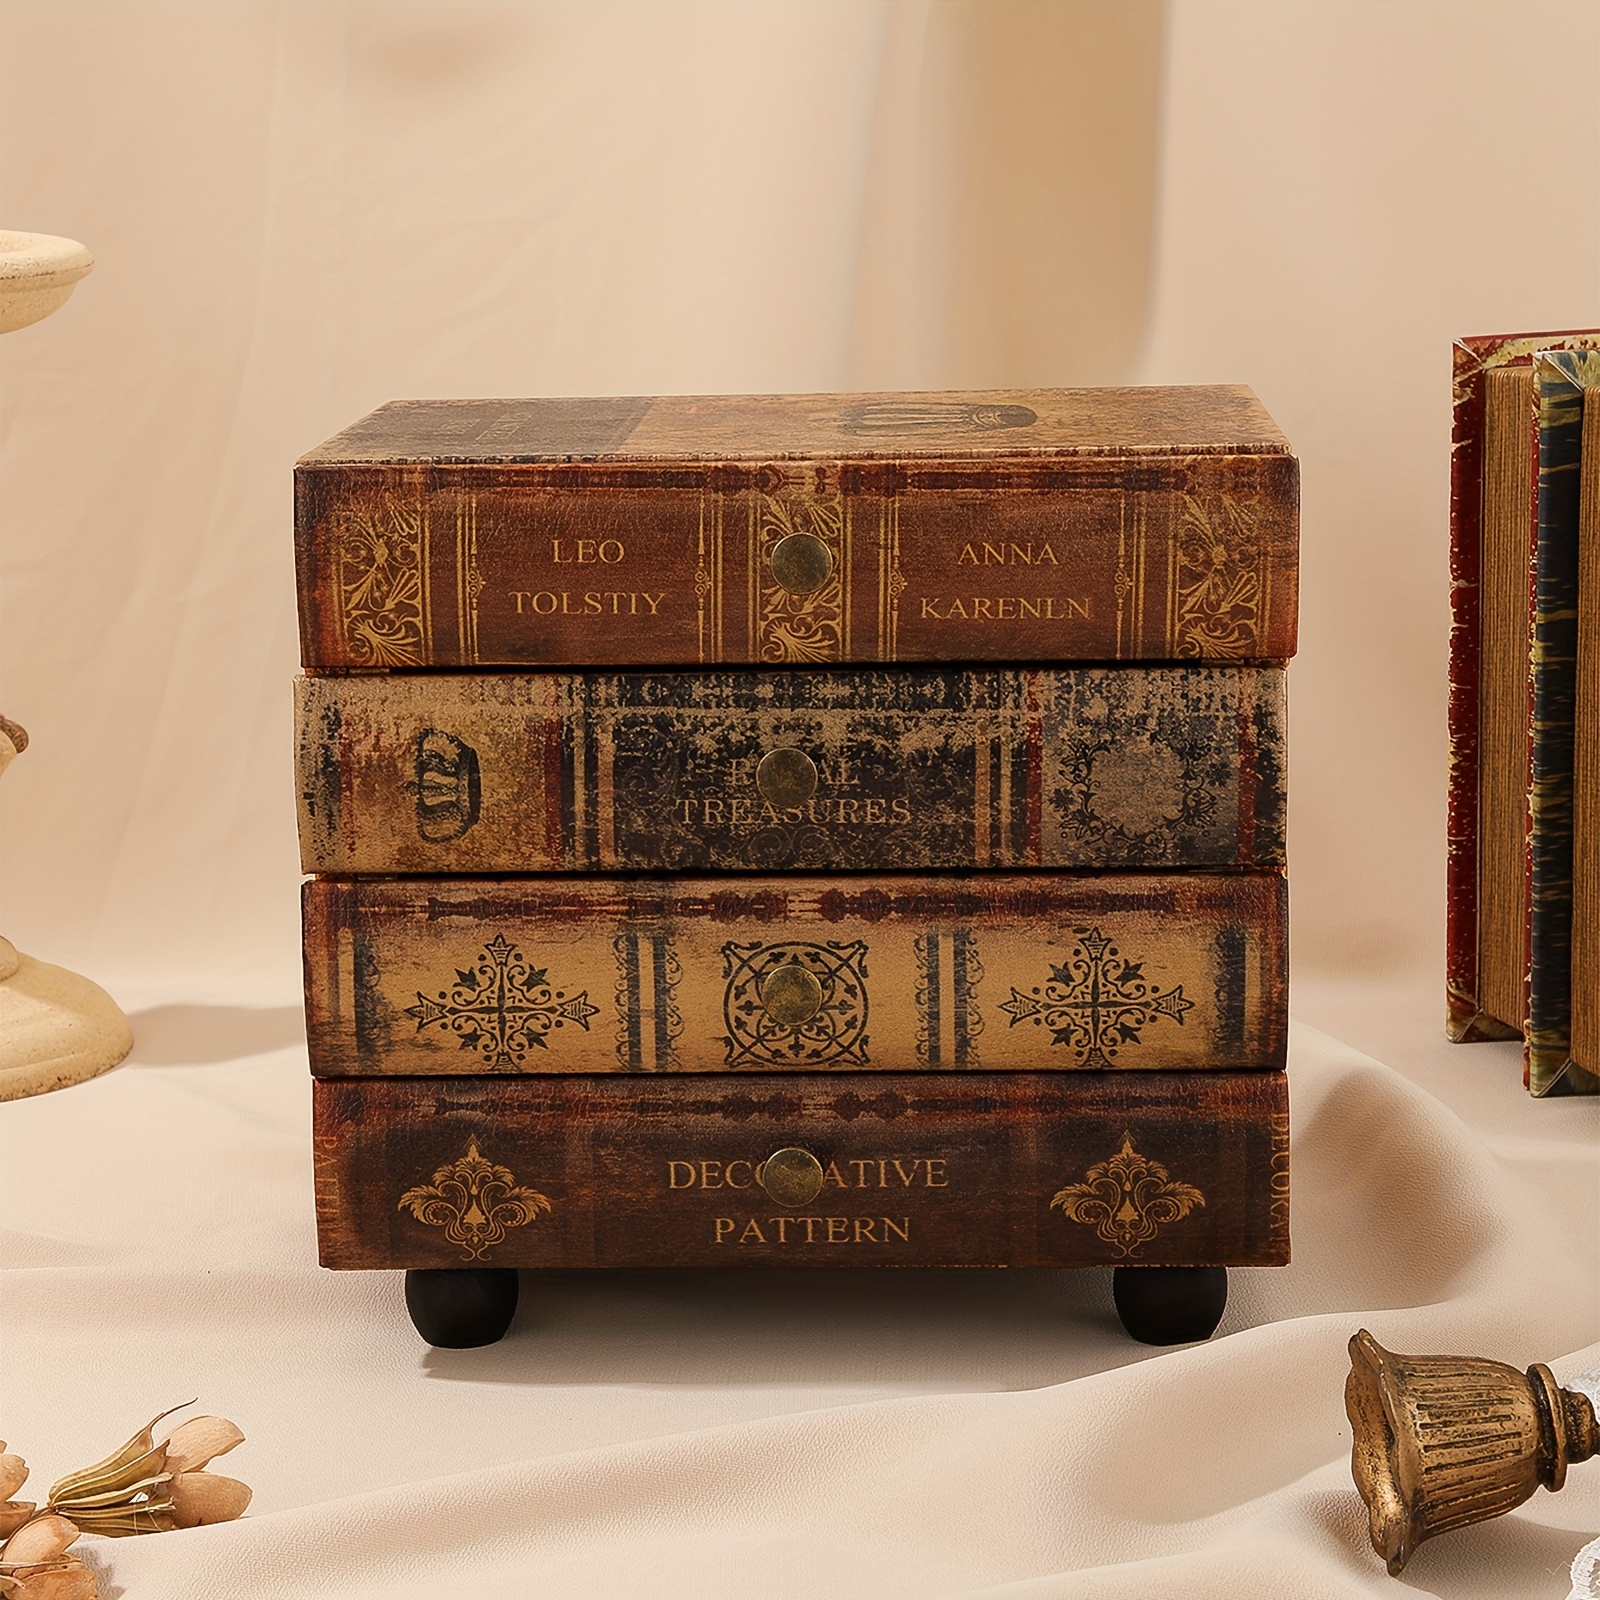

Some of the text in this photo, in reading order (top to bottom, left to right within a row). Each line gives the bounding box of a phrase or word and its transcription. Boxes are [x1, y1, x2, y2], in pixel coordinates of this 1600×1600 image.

[551, 539, 625, 565] LEO
[957, 543, 1059, 566] ANNA
[509, 591, 666, 616] TOLSTIY
[675, 799, 912, 825] TREASURES
[667, 1159, 949, 1189] DECATIVE
[715, 1217, 910, 1244] PATTERN
